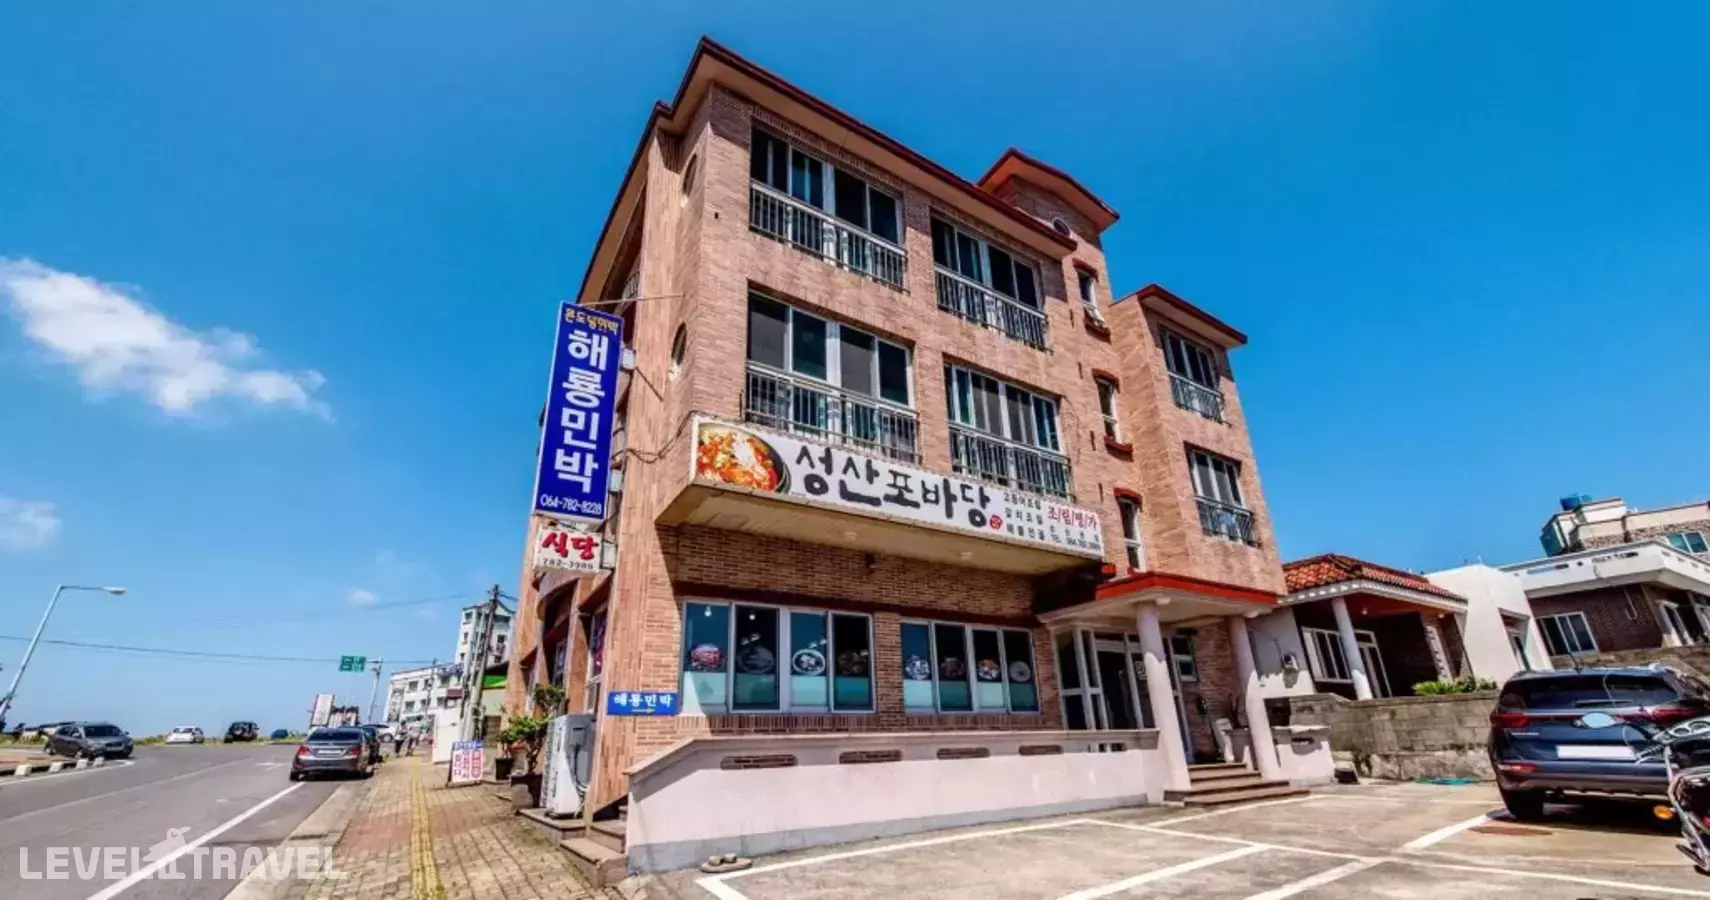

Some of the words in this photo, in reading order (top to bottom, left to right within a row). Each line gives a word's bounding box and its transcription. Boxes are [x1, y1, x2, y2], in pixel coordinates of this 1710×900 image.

[555, 330, 609, 494] 해룡민박
[540, 493, 602, 515] 064-782-8228
[796, 445, 991, 528] 성산포바당
[542, 531, 599, 561] 식당
